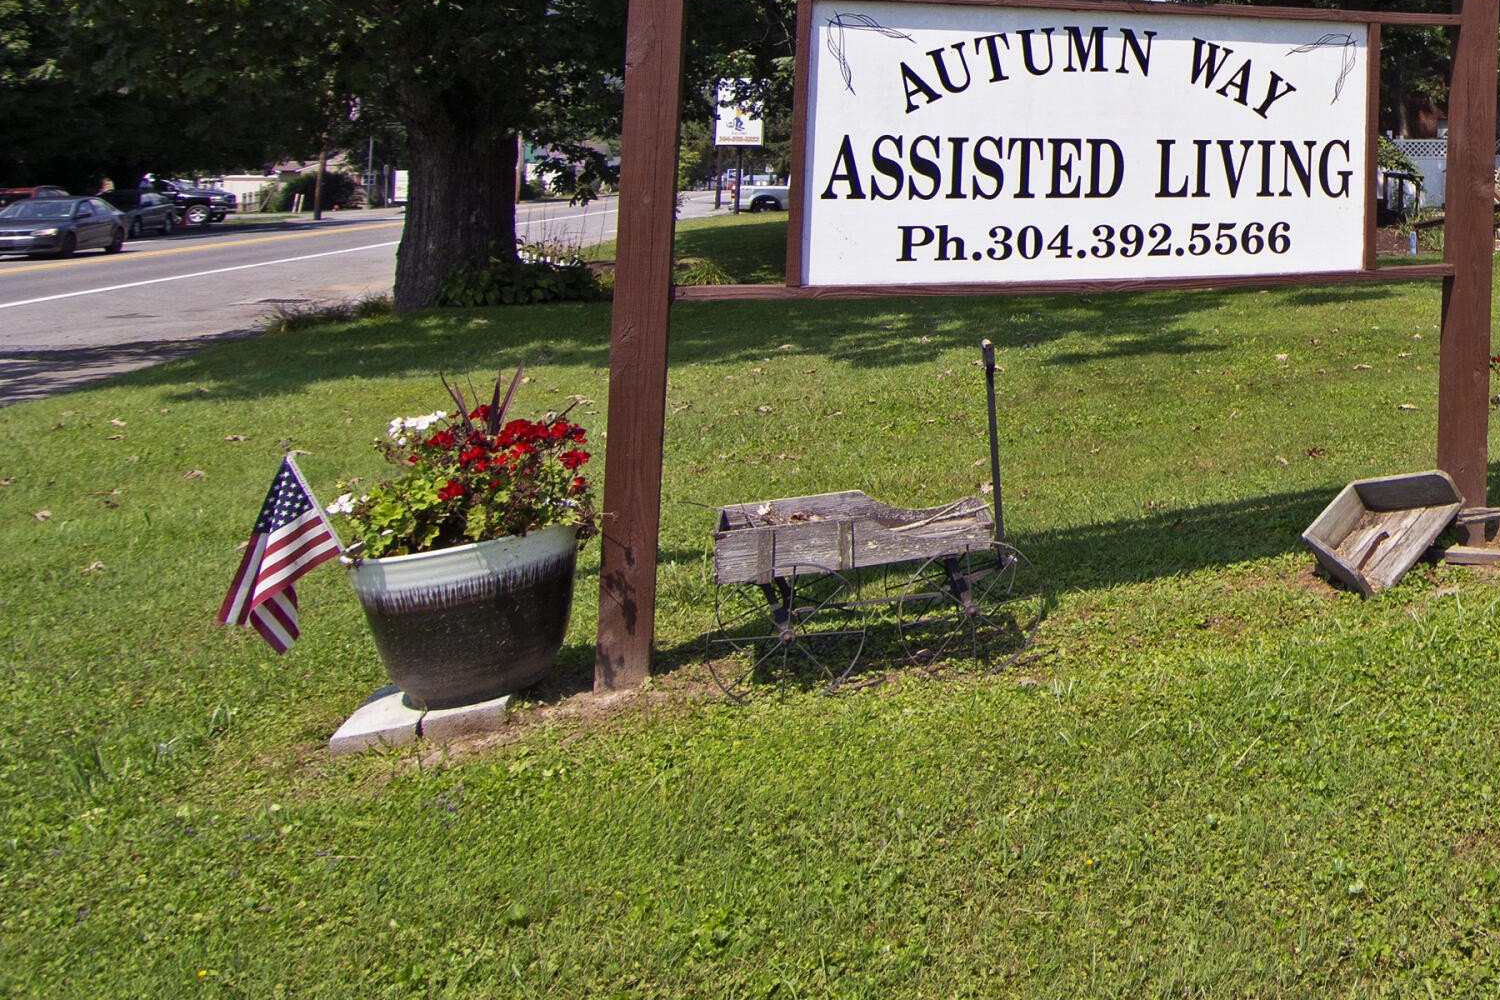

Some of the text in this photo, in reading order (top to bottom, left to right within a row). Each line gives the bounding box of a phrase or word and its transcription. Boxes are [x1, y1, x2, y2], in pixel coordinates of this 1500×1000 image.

[898, 25, 1297, 120] AUTUMN WAY
[820, 134, 1354, 201] ASSISTED LIVING
[895, 221, 1291, 262] Ph.304.392.5566
